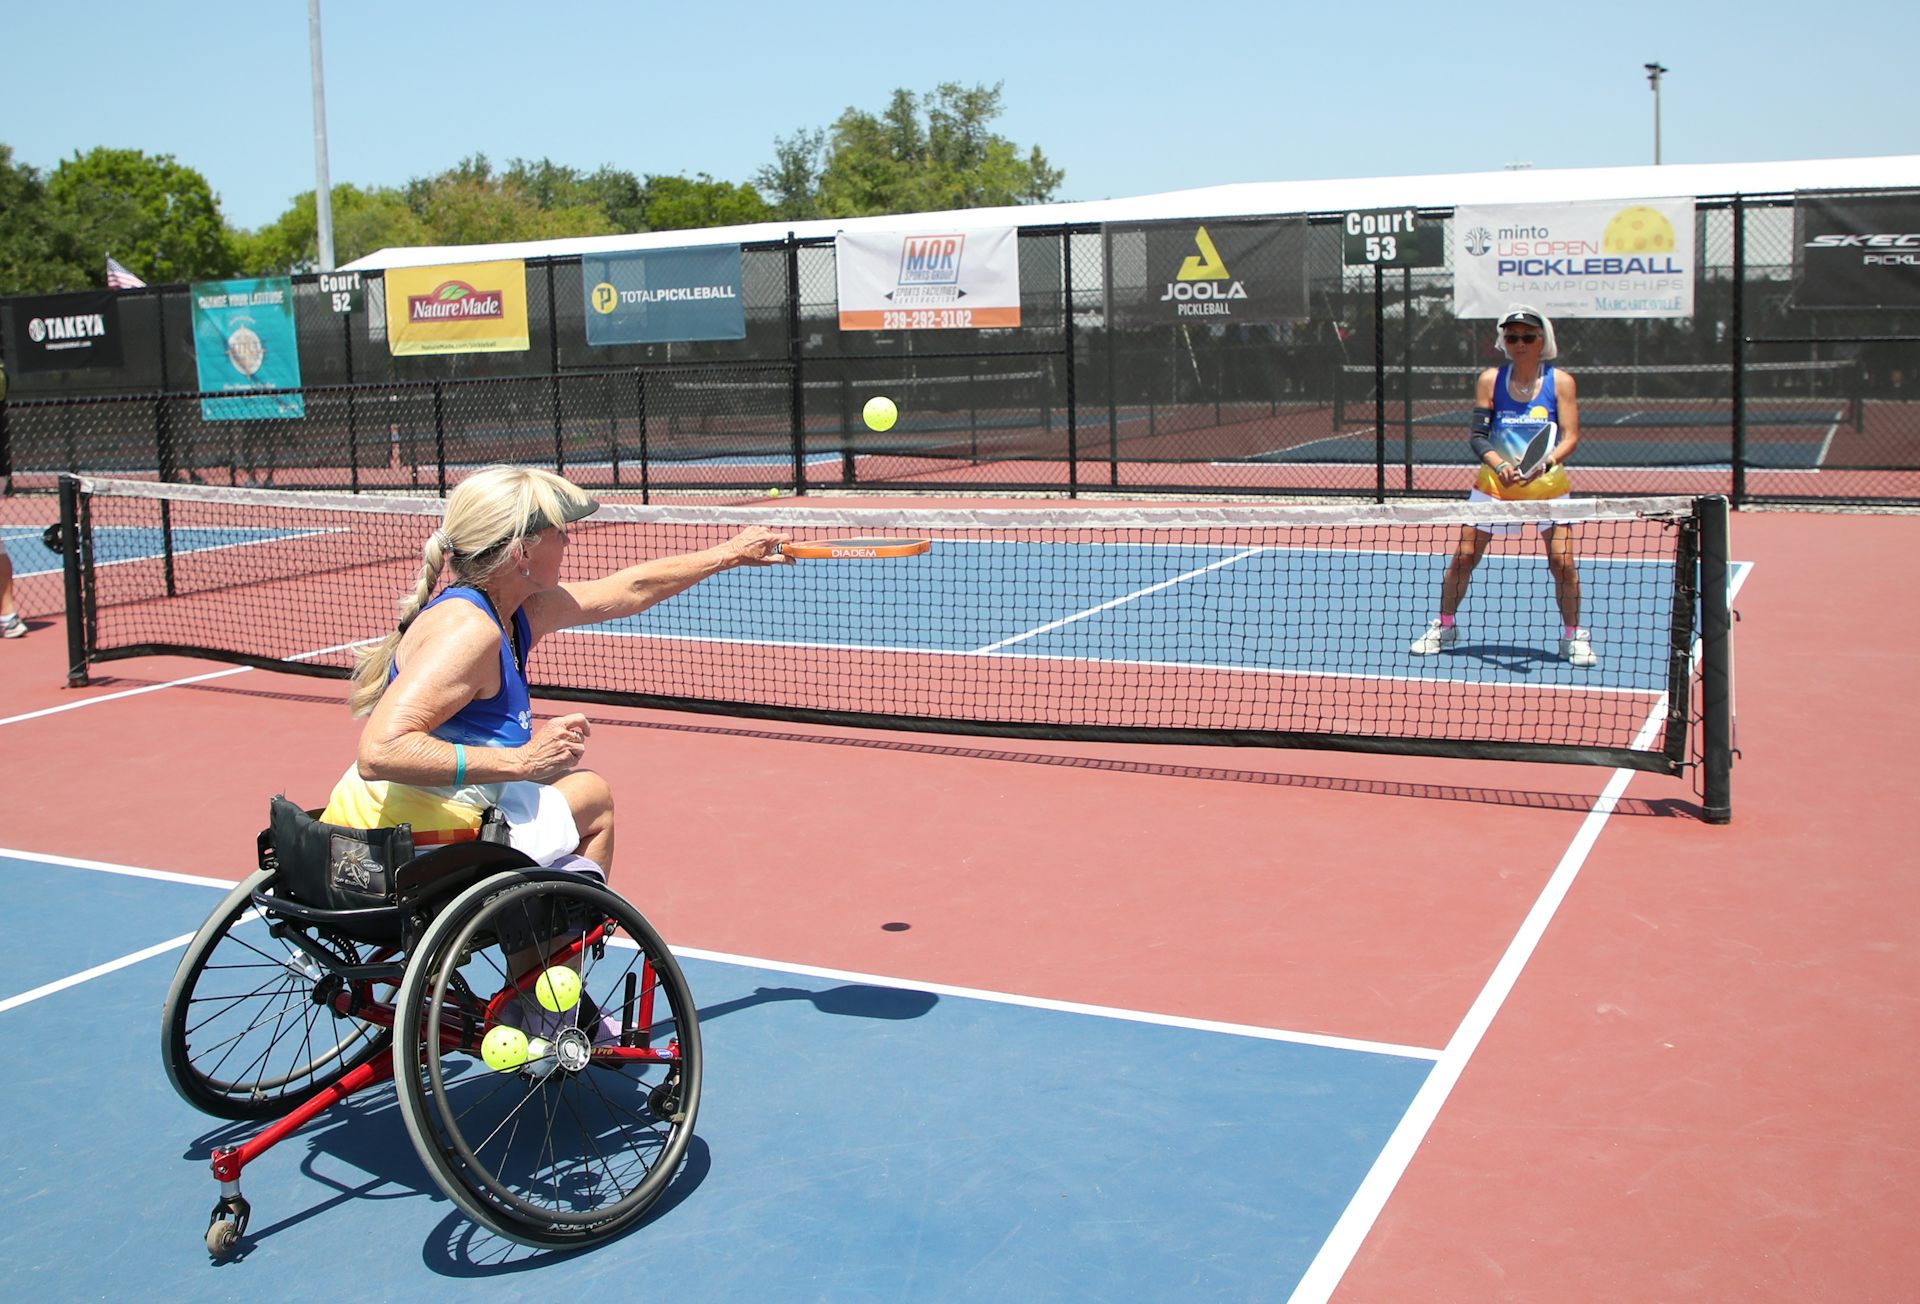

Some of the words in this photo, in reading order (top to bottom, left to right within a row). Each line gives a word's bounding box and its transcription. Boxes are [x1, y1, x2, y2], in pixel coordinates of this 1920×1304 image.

[1346, 209, 1414, 235] Court
[1498, 225, 1549, 239] minto
[907, 239, 957, 270] MOR
[1365, 236, 1397, 261] 53
[1498, 241, 1529, 256] US
[1534, 240, 1599, 256] OPEN
[1497, 257, 1684, 276] PICKLEBALL
[319, 272, 361, 293] Court
[895, 287, 921, 297] SPORTS
[1160, 281, 1248, 301] JOOLA
[1498, 278, 1684, 292] CHAMPIONSHIPS
[331, 292, 352, 312] 52
[620, 285, 736, 304] TOTALPICKLEBALL
[1178, 303, 1231, 316] PICKLEBALL
[44, 313, 106, 340] TAKEYA
[883, 310, 972, 329] 239-292-3102
[831, 549, 877, 558] DIADEM
